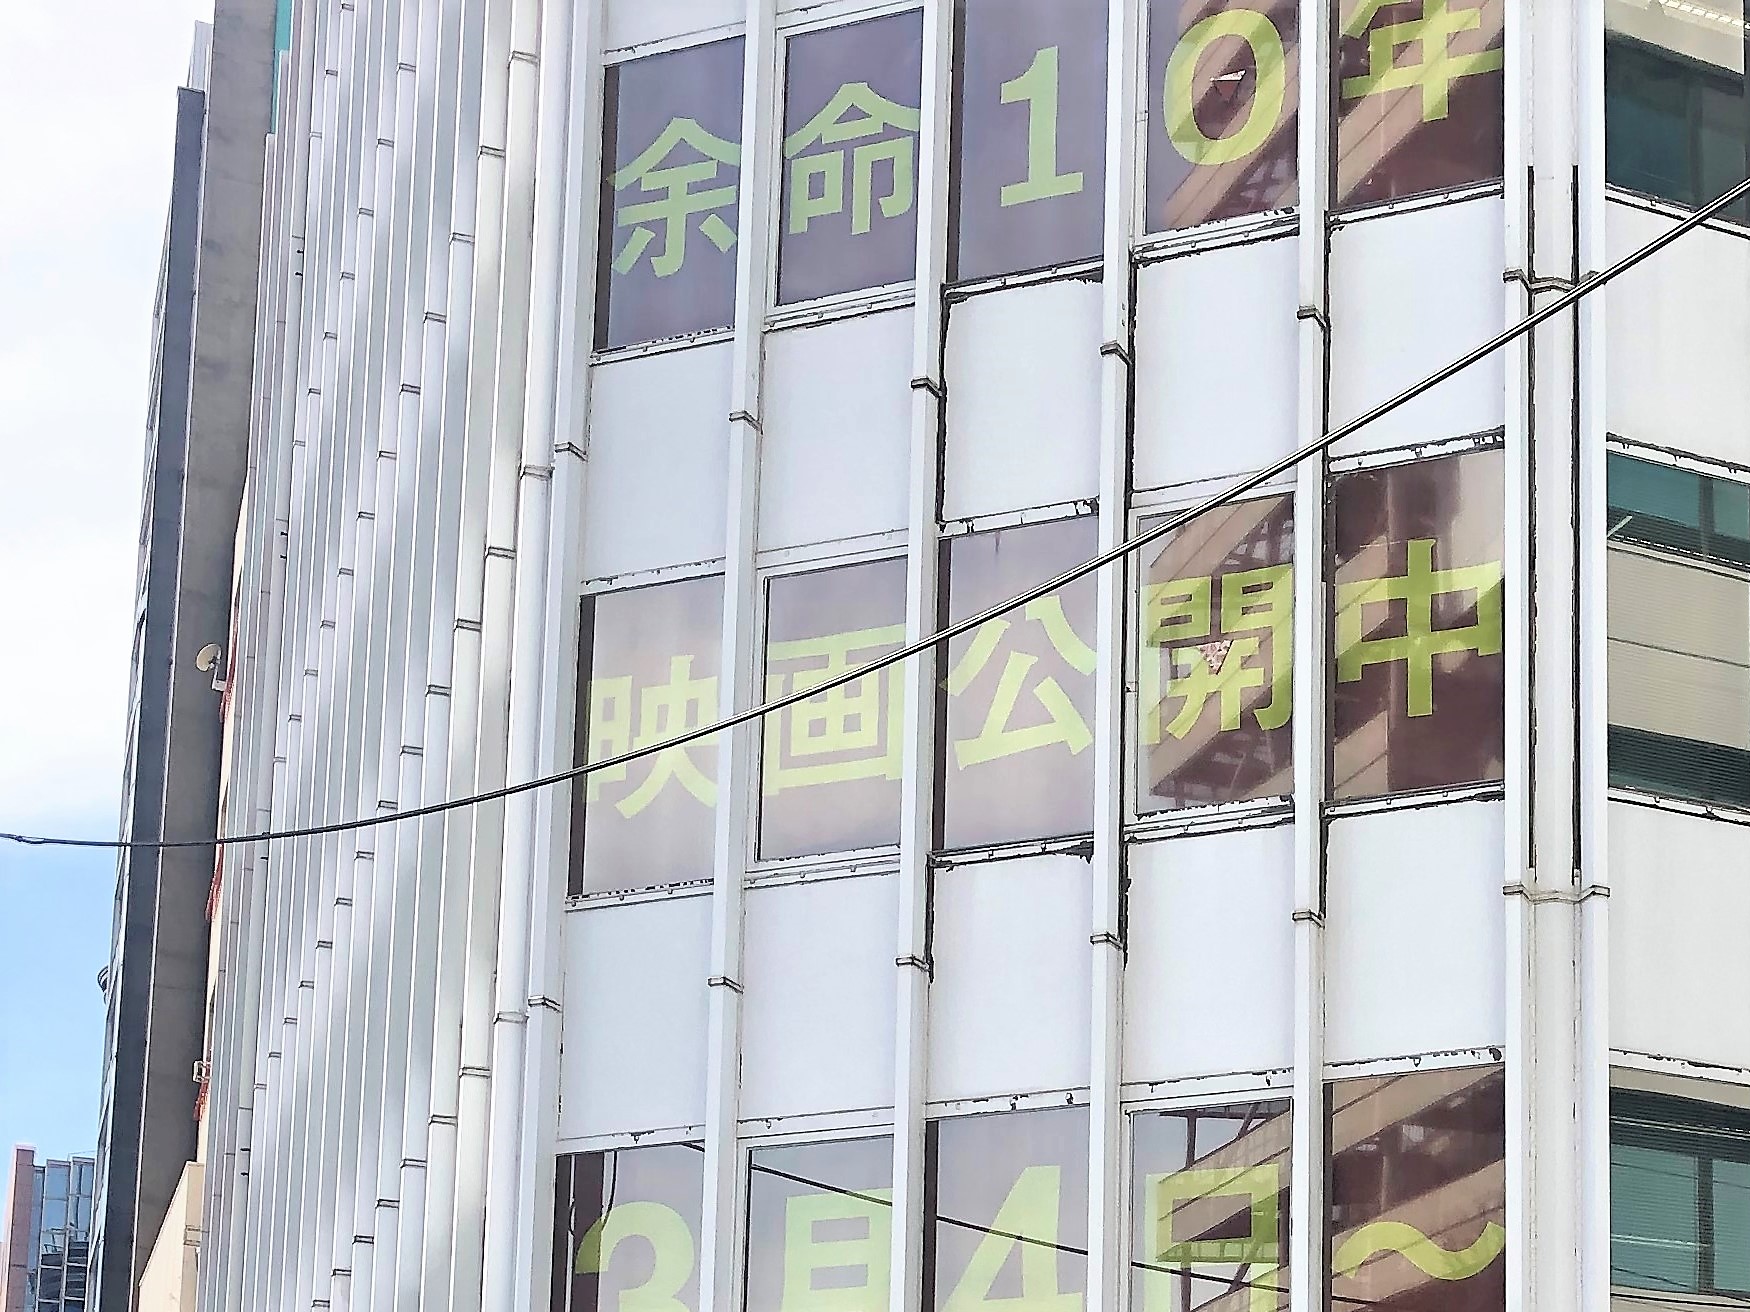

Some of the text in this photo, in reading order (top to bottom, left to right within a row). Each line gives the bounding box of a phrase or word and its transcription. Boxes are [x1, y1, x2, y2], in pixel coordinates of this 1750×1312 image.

[587, 540, 1503, 817] 映画公開中
